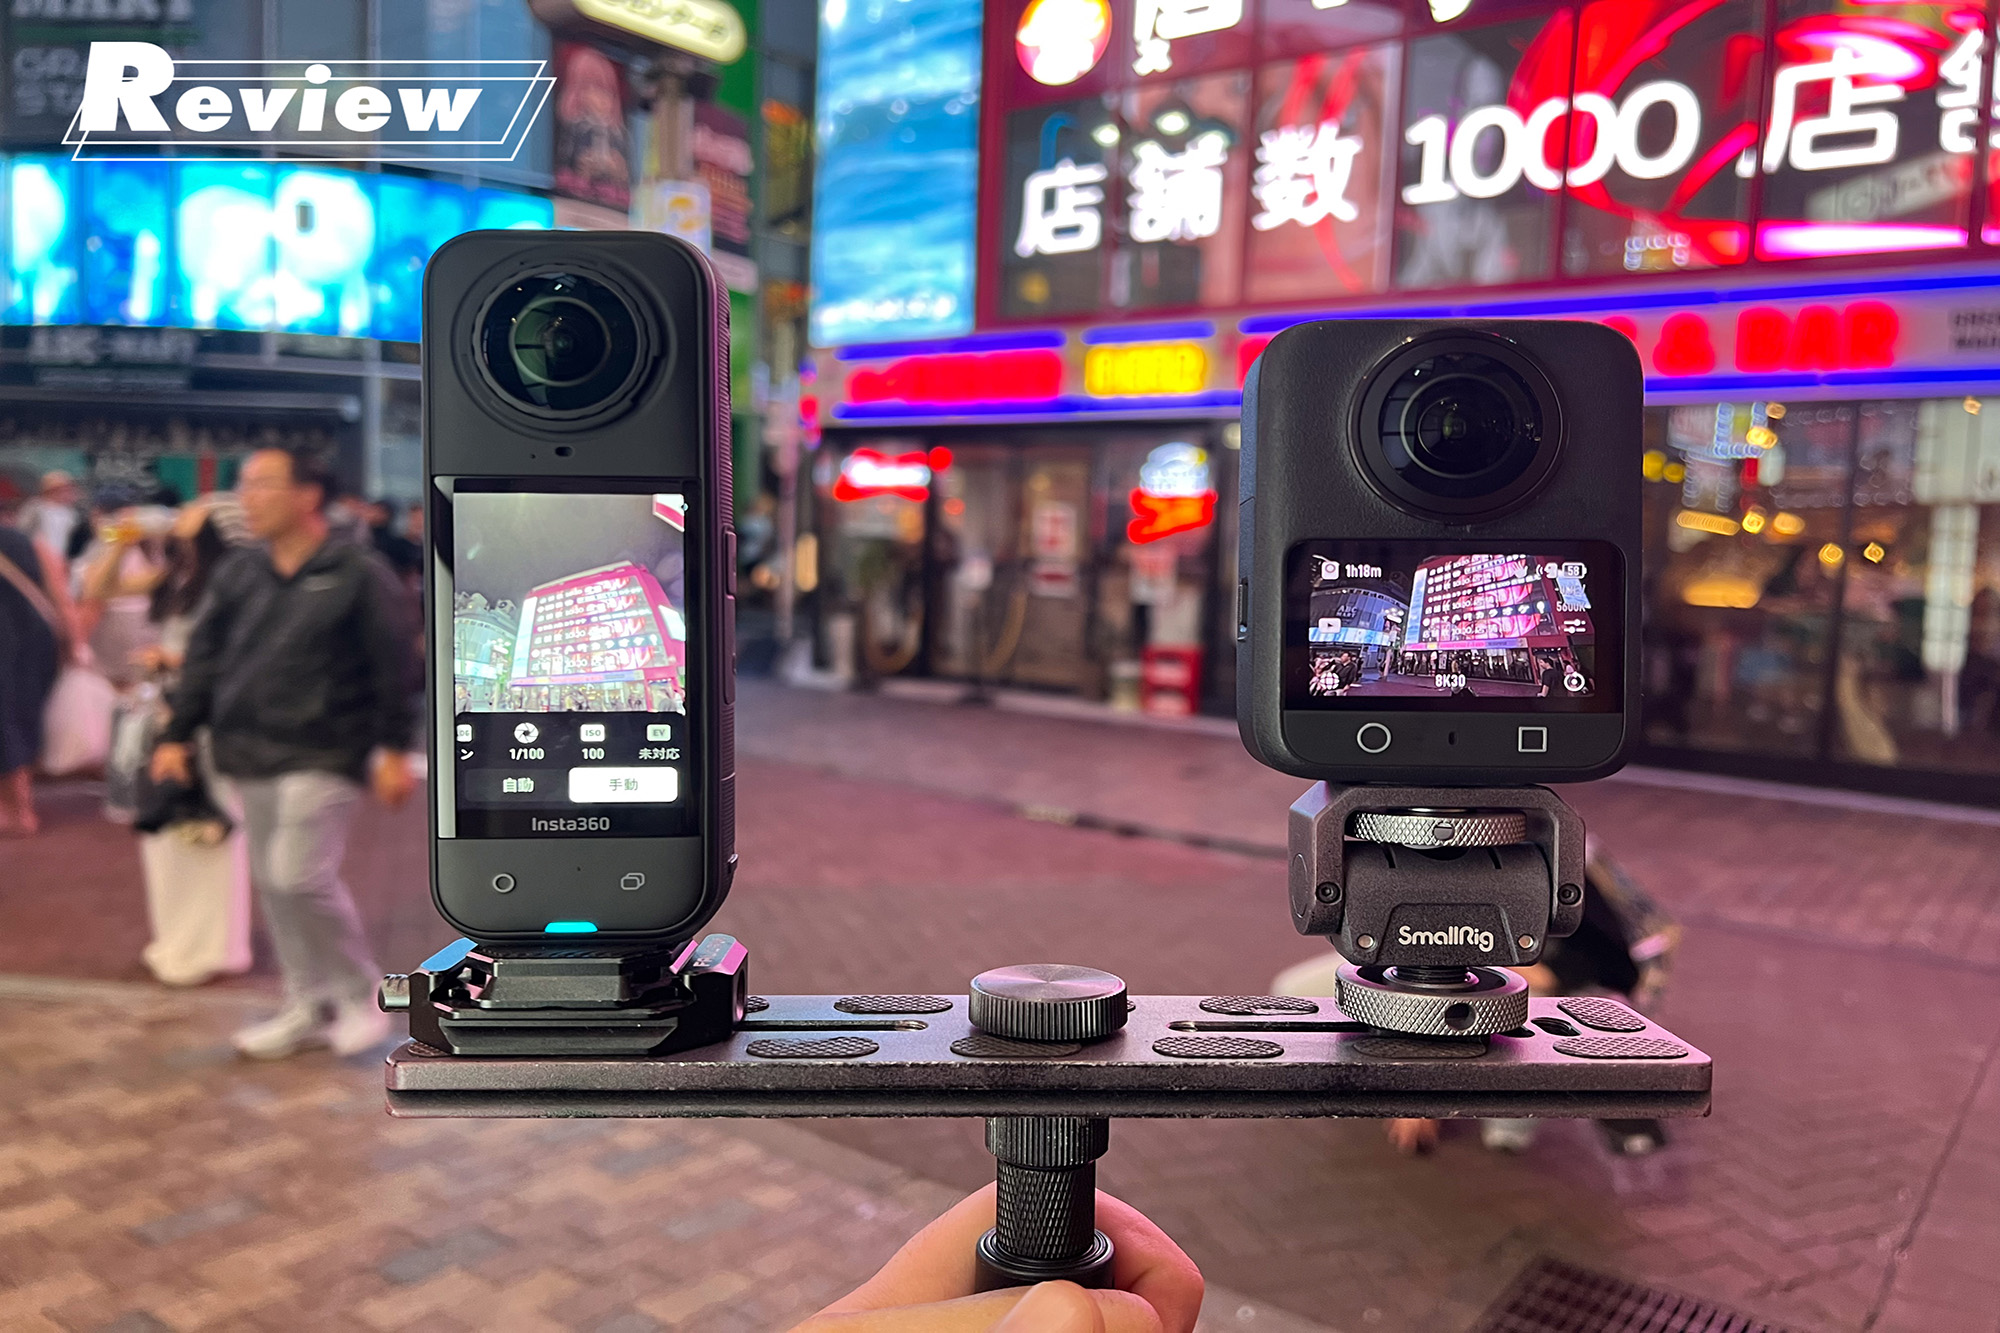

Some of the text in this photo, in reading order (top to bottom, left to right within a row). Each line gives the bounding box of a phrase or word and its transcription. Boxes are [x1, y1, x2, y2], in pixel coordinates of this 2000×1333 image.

[1345, 564, 1382, 578] 1h18m
[1567, 565, 1580, 576] 58
[1556, 601, 1586, 612] 5600K
[1435, 674, 1466, 688] 8K30
[585, 729, 602, 737] ISO
[652, 729, 666, 737] EV
[509, 748, 545, 760] 1/100
[581, 747, 605, 760] 100
[638, 747, 681, 760] 未対応
[502, 777, 534, 793] 自動
[608, 778, 639, 792] 手動
[531, 817, 610, 831] Insta360
[1398, 925, 1495, 953] SmallRig
